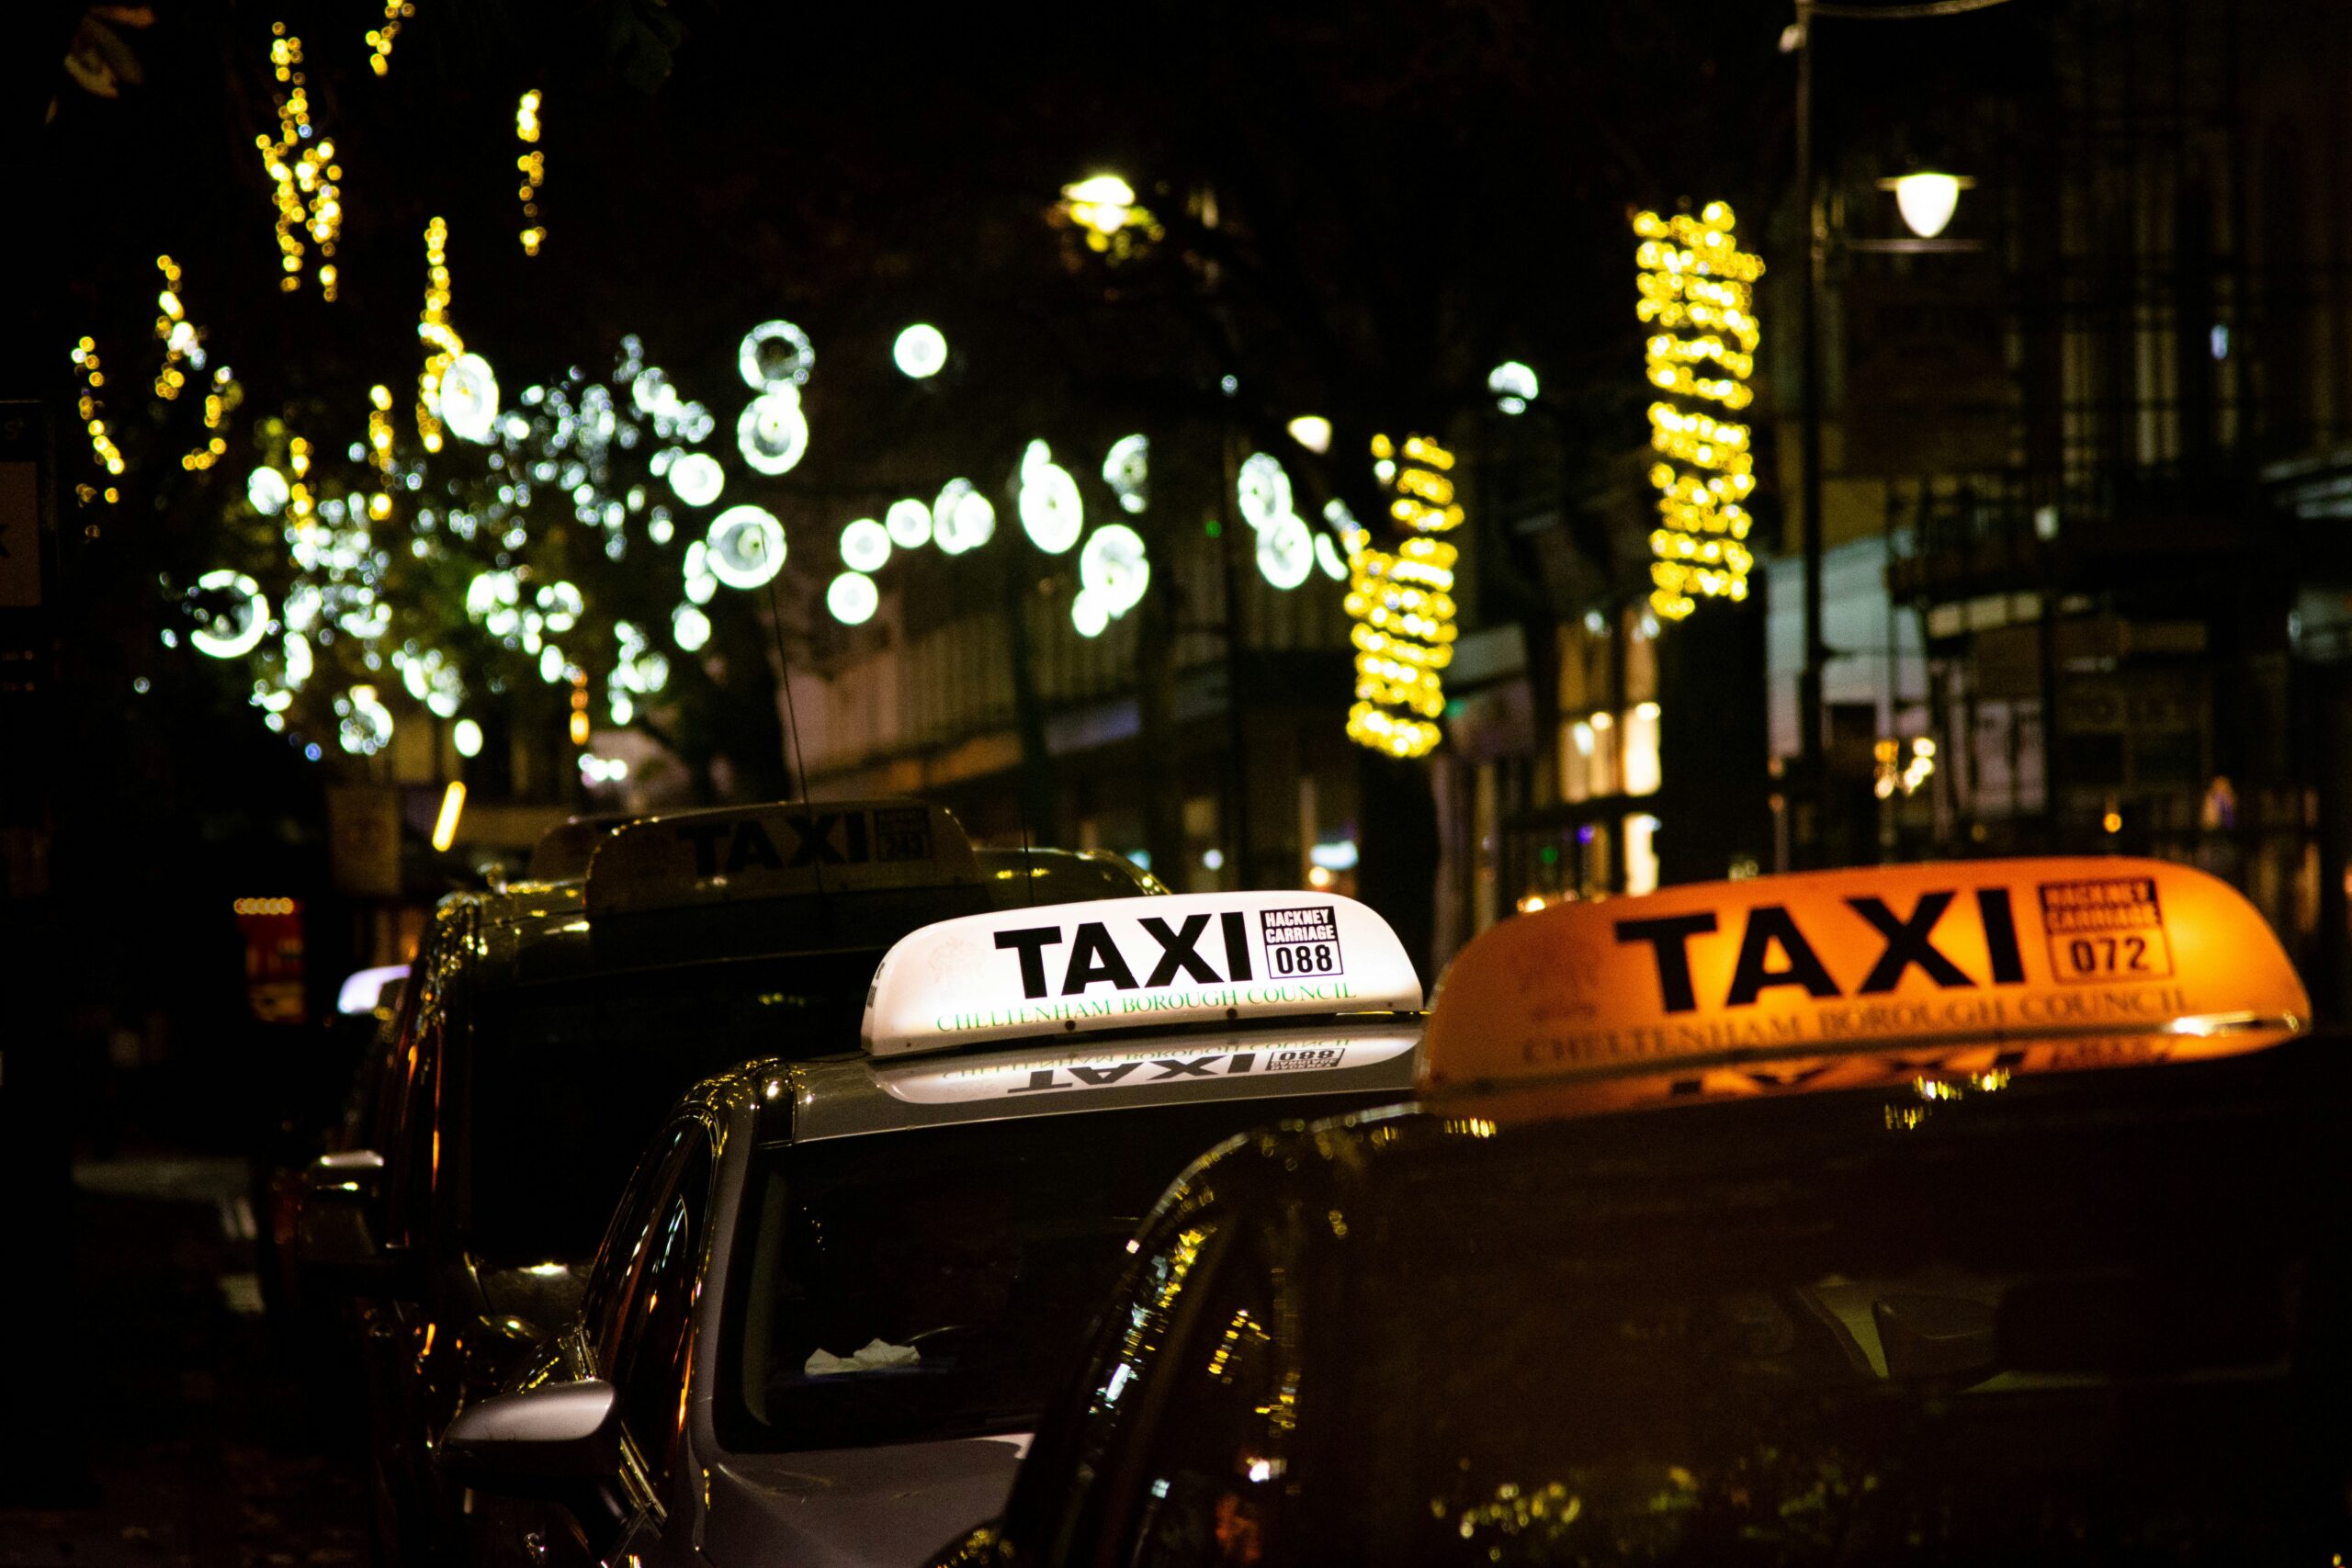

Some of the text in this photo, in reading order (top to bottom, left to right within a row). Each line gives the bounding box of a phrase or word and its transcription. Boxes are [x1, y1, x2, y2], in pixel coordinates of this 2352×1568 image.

[676, 810, 868, 875] TAXI
[1265, 909, 1329, 928] HACKNEY
[1265, 925, 1335, 943] CARRIAGE
[993, 911, 1253, 999] TAXI
[1276, 944, 1332, 974] 088
[1616, 889, 2025, 1012] TAXI
[2070, 937, 2151, 974] 072
[936, 982, 1357, 1032] CHELTENHAM BOROUGH COUNCIL
